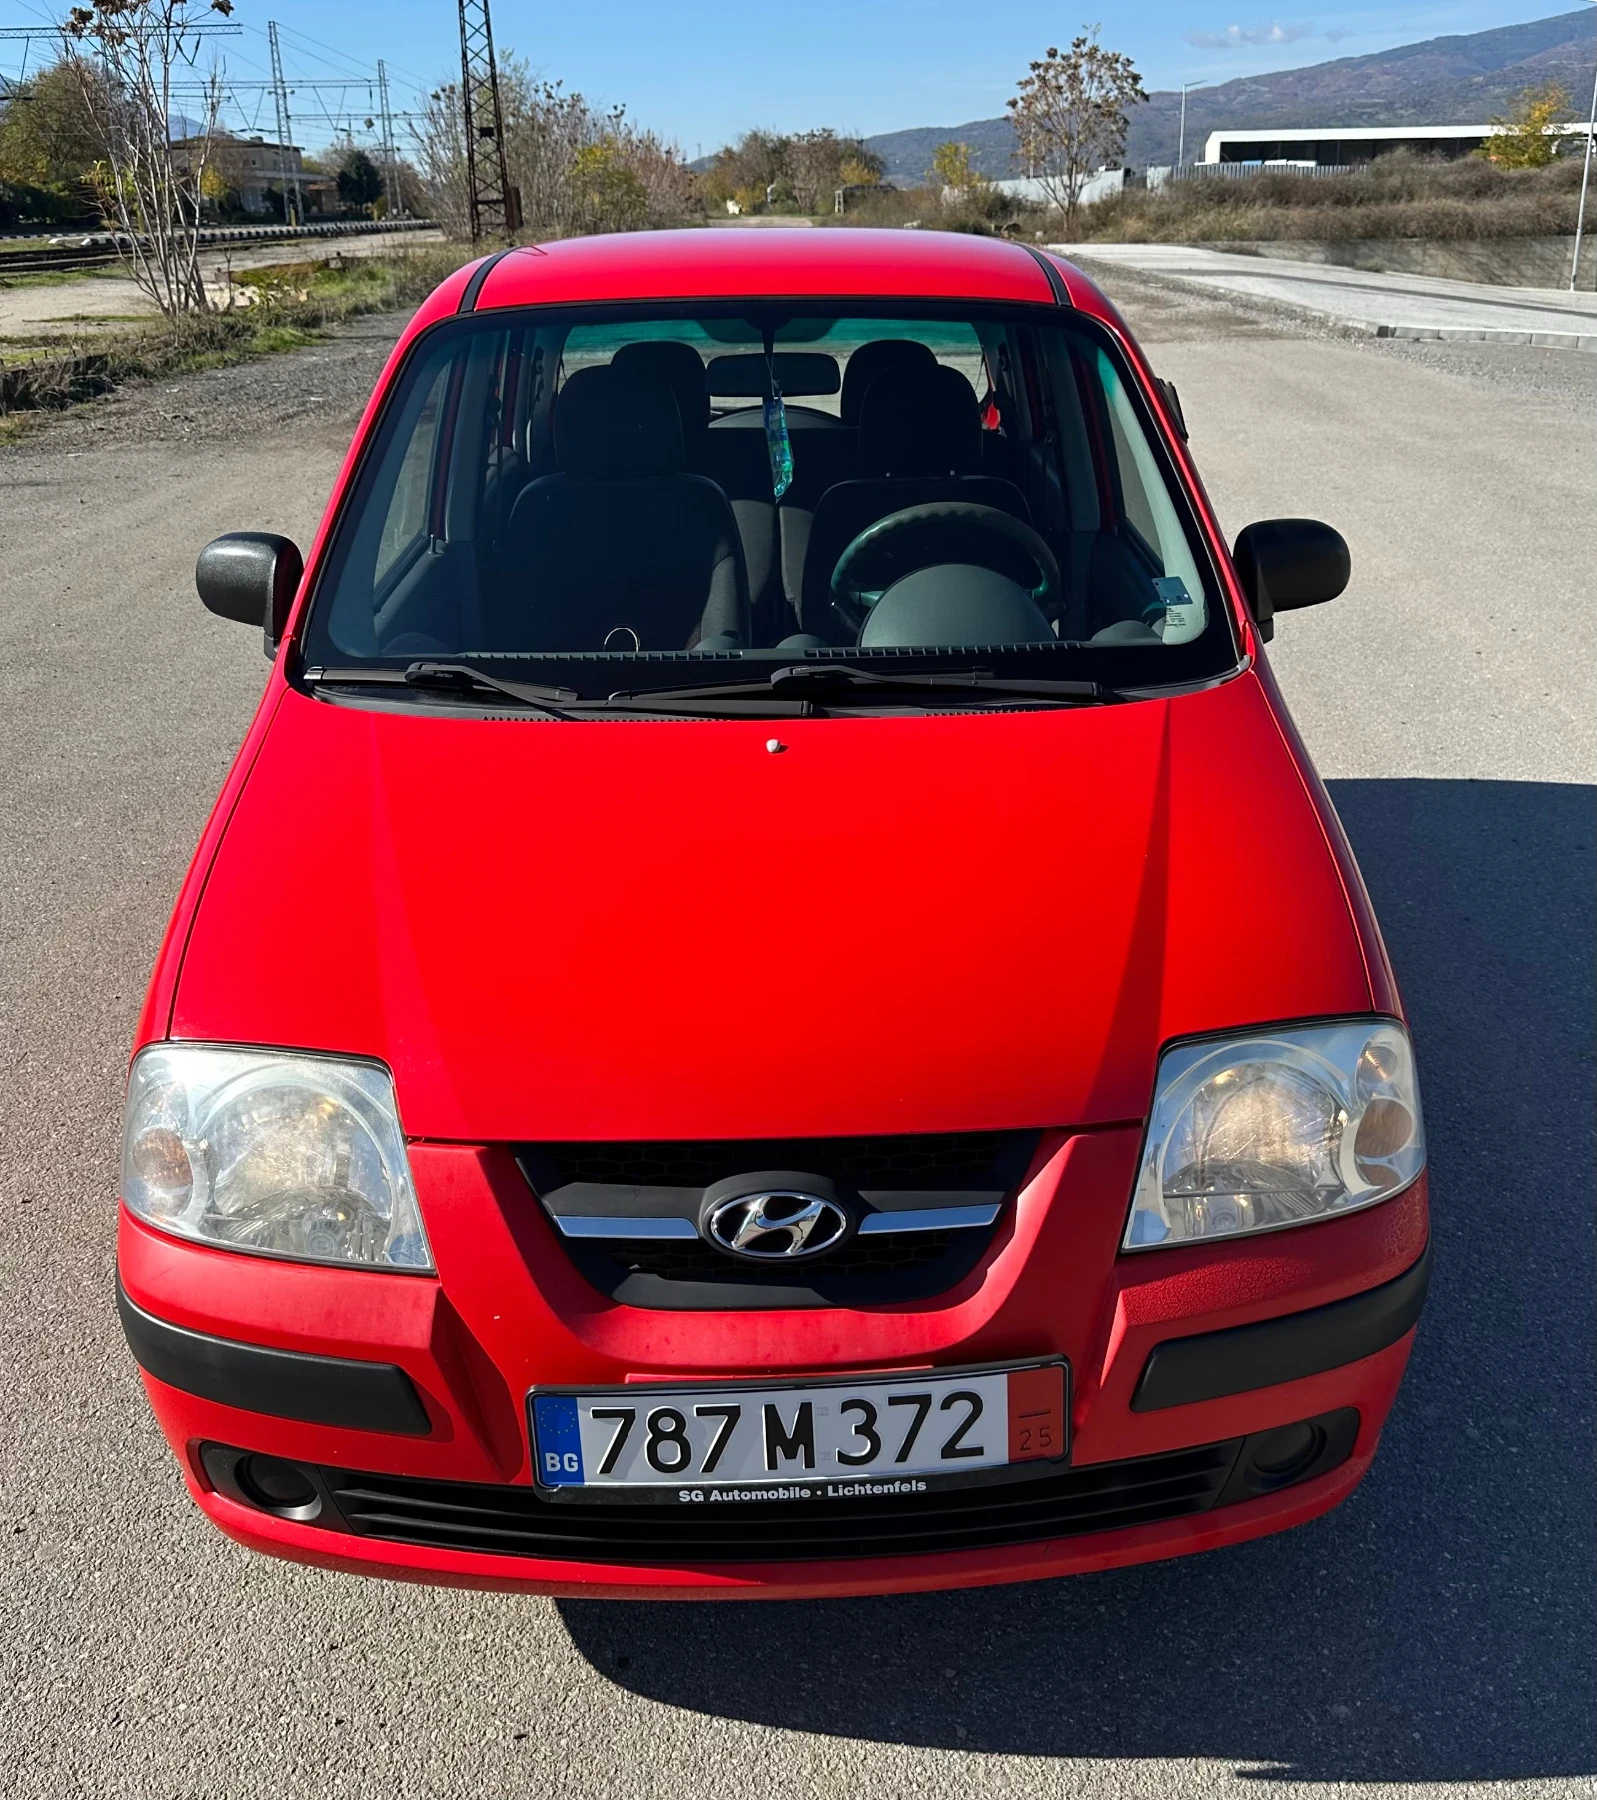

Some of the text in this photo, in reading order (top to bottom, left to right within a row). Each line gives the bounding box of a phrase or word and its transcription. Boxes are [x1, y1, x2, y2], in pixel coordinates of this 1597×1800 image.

[590, 1391, 985, 1475] 787 M 372
[1019, 1425, 1053, 1452] 25
[544, 1452, 579, 1473] BG
[678, 1479, 927, 1503] SG Automobile Lichtenfels
